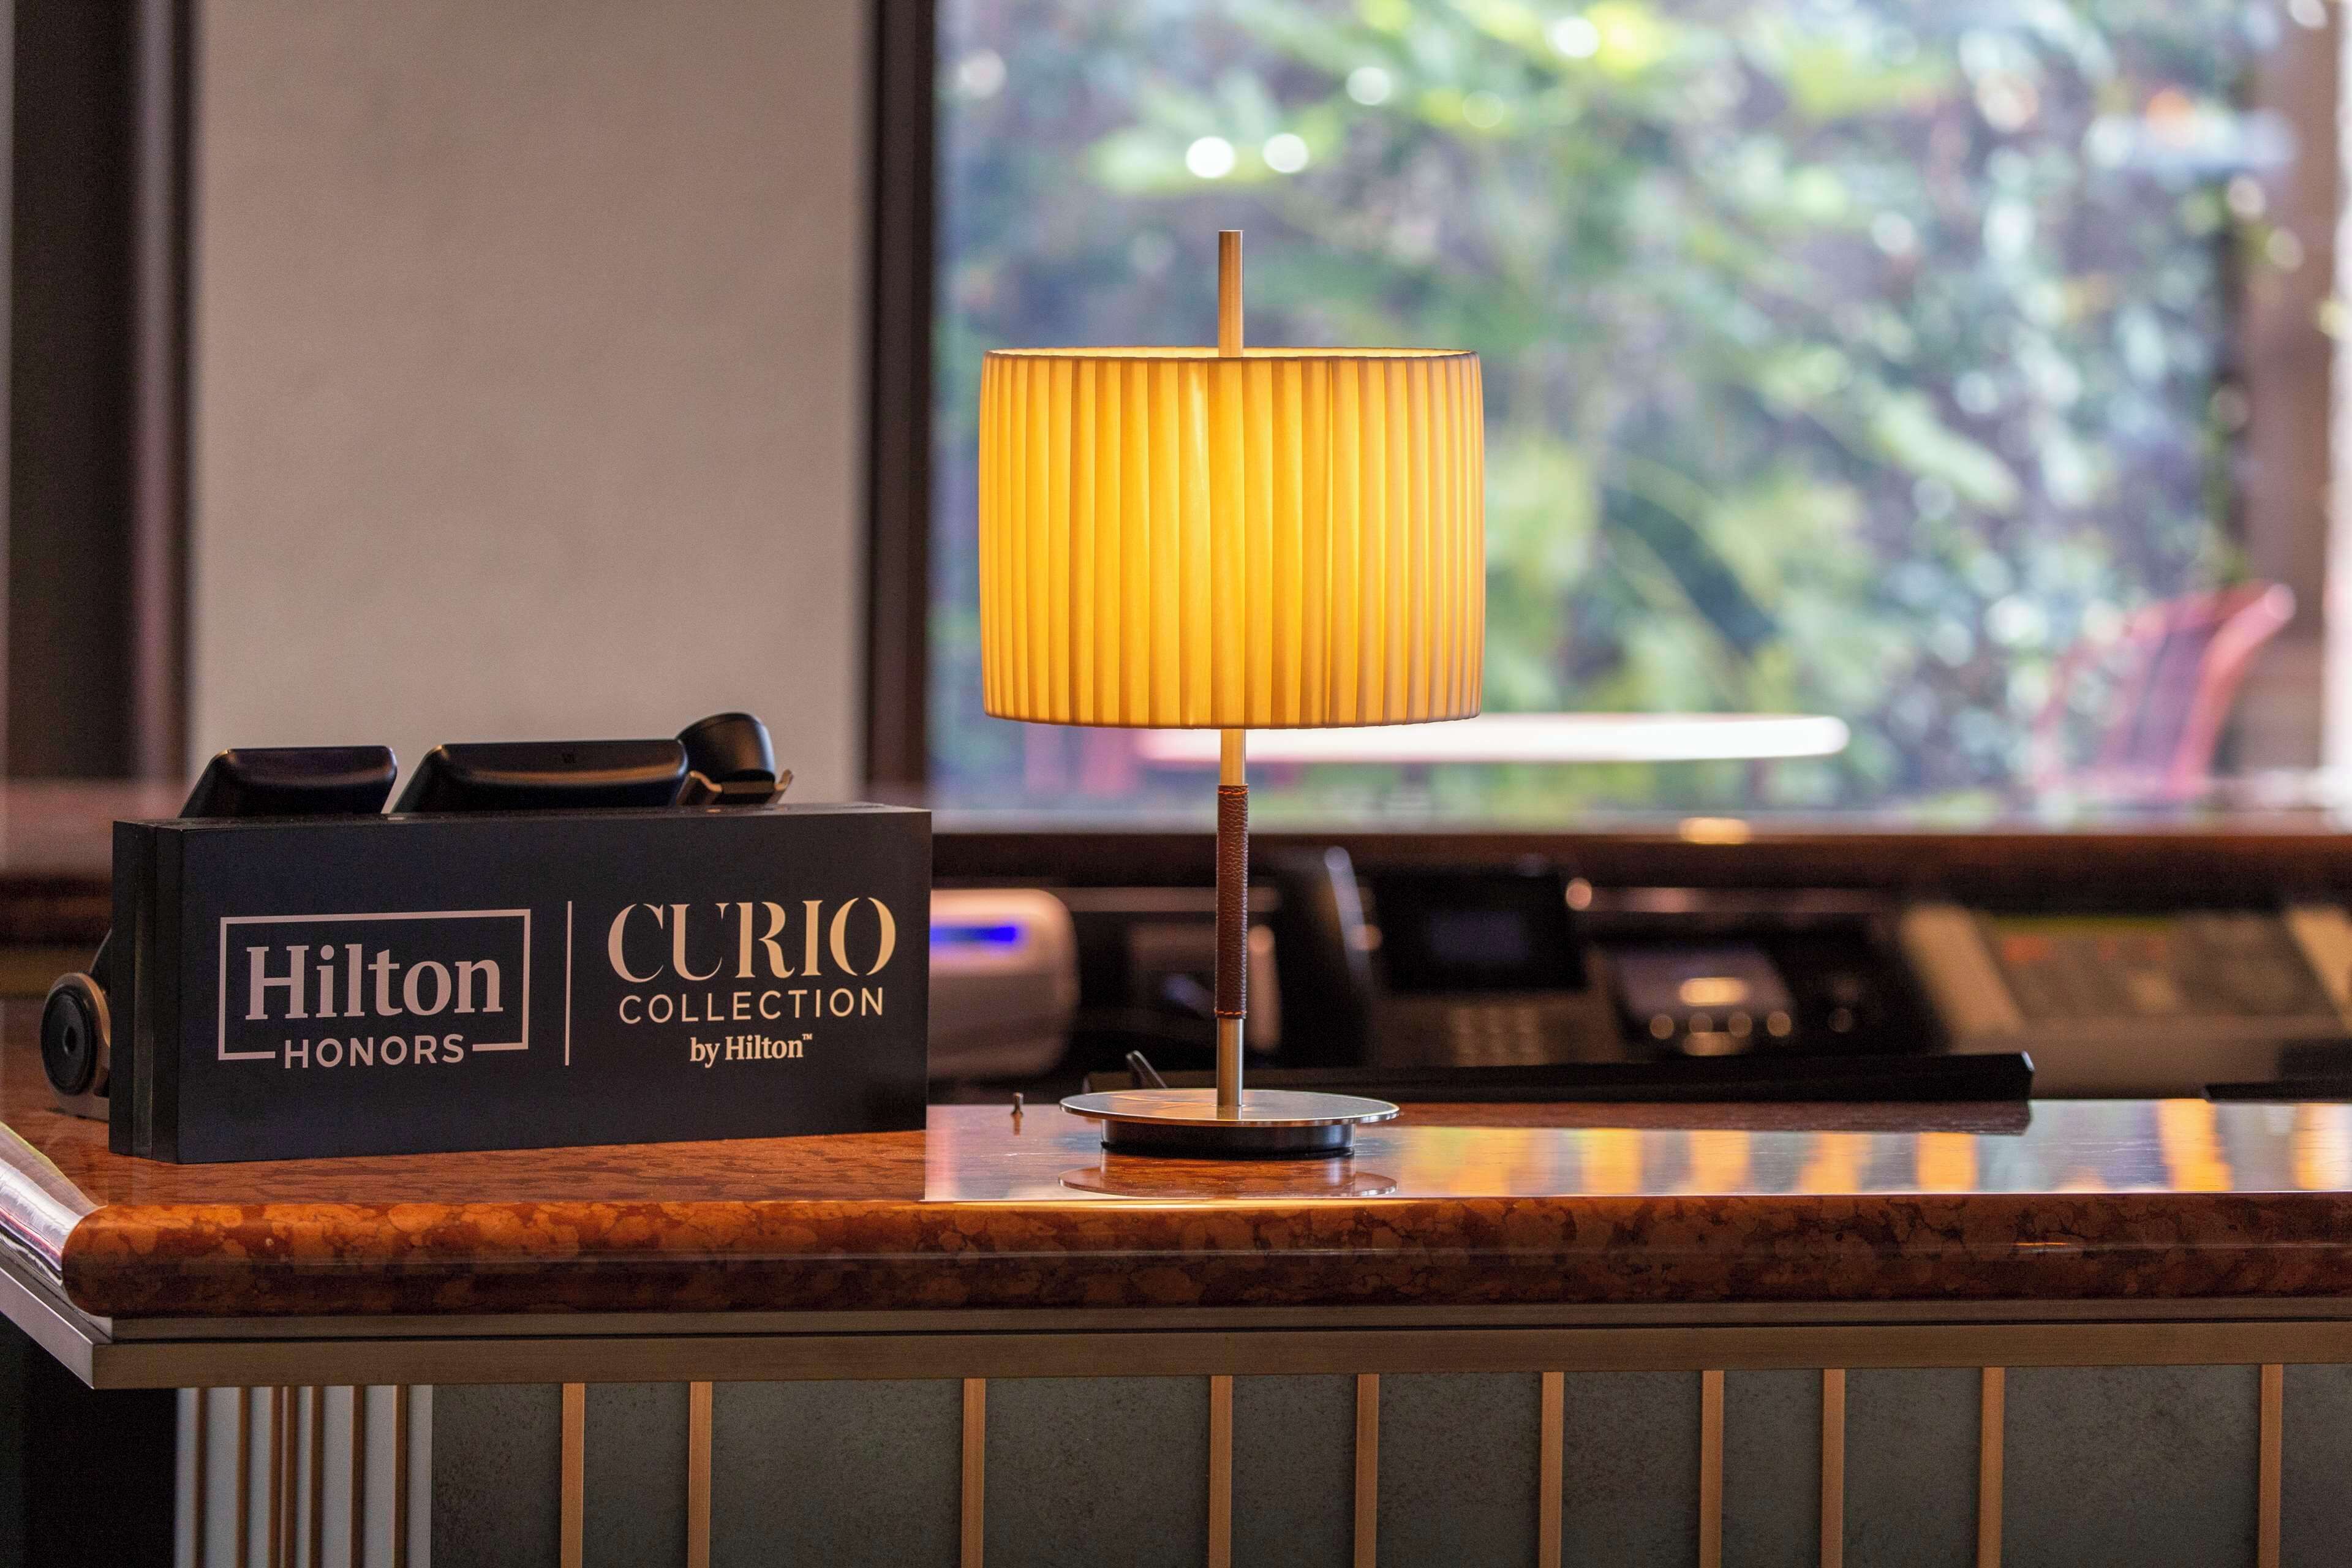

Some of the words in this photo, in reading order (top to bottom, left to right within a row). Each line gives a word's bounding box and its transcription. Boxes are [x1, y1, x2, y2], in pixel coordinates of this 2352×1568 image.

[608, 897, 897, 983] CURIO
[245, 943, 503, 1020] Hilton
[619, 987, 883, 1024] COLLECTION
[284, 1033, 464, 1069] HONORS
[690, 1037, 720, 1069] by
